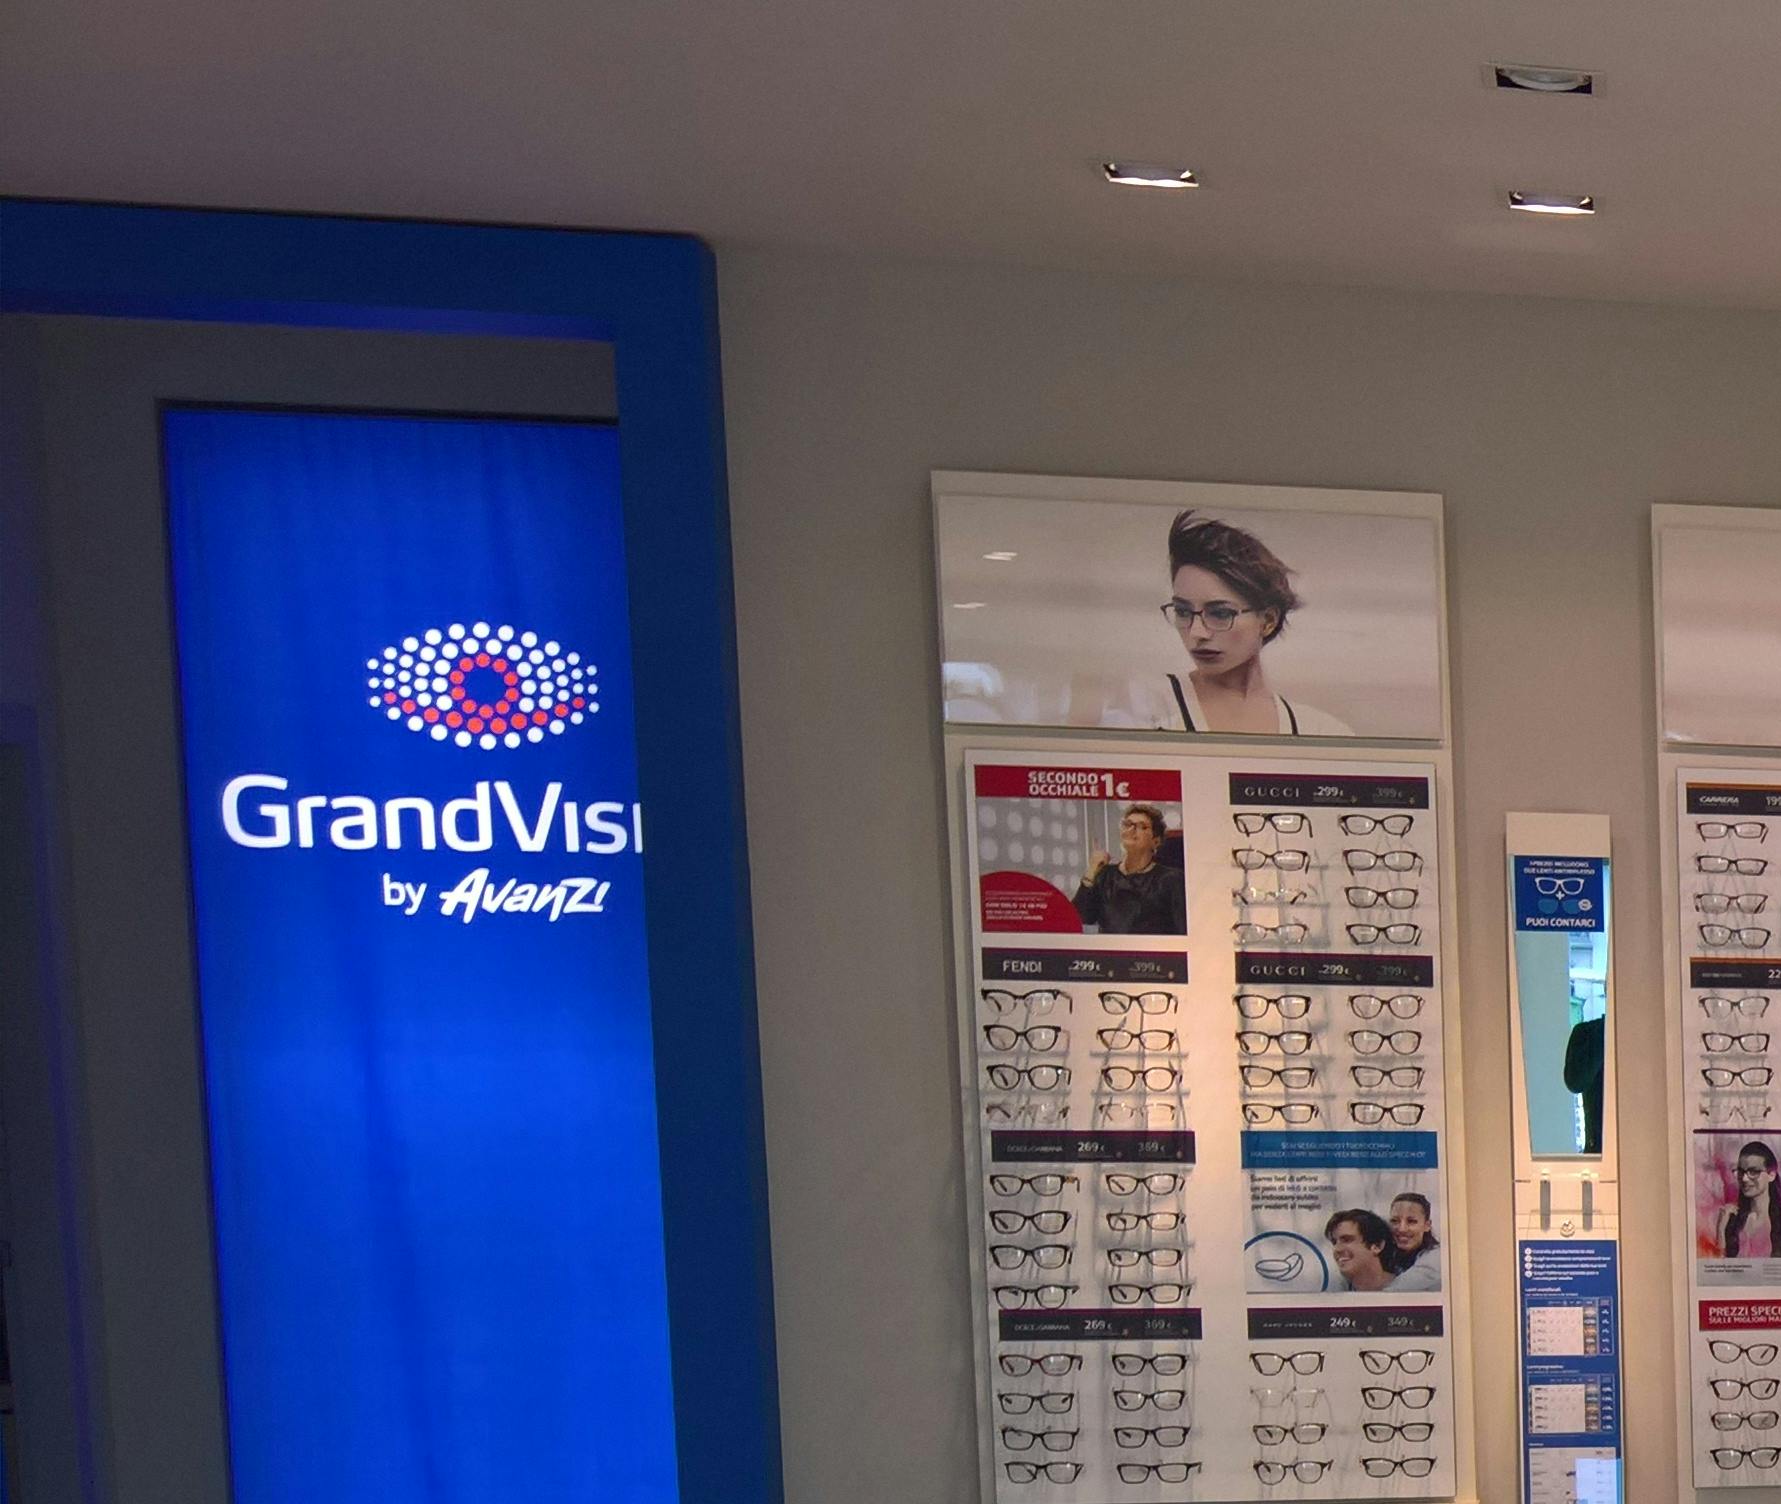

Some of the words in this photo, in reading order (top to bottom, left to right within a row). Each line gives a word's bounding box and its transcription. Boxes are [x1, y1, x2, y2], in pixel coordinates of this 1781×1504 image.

[1028, 771, 1098, 784] SECONDO
[1029, 784, 1099, 796] OCCHIALE
[1101, 773, 1130, 797] 1€
[1244, 786, 1299, 797] GUCCI
[221, 774, 643, 854] GrandVisi
[383, 873, 427, 915] by
[1526, 917, 1549, 927] PUOI
[1550, 918, 1596, 927] CONTARCI
[1003, 960, 1042, 973] FENDI
[1250, 965, 1305, 976] GUCCI
[1709, 1306, 1749, 1317] PREZZI
